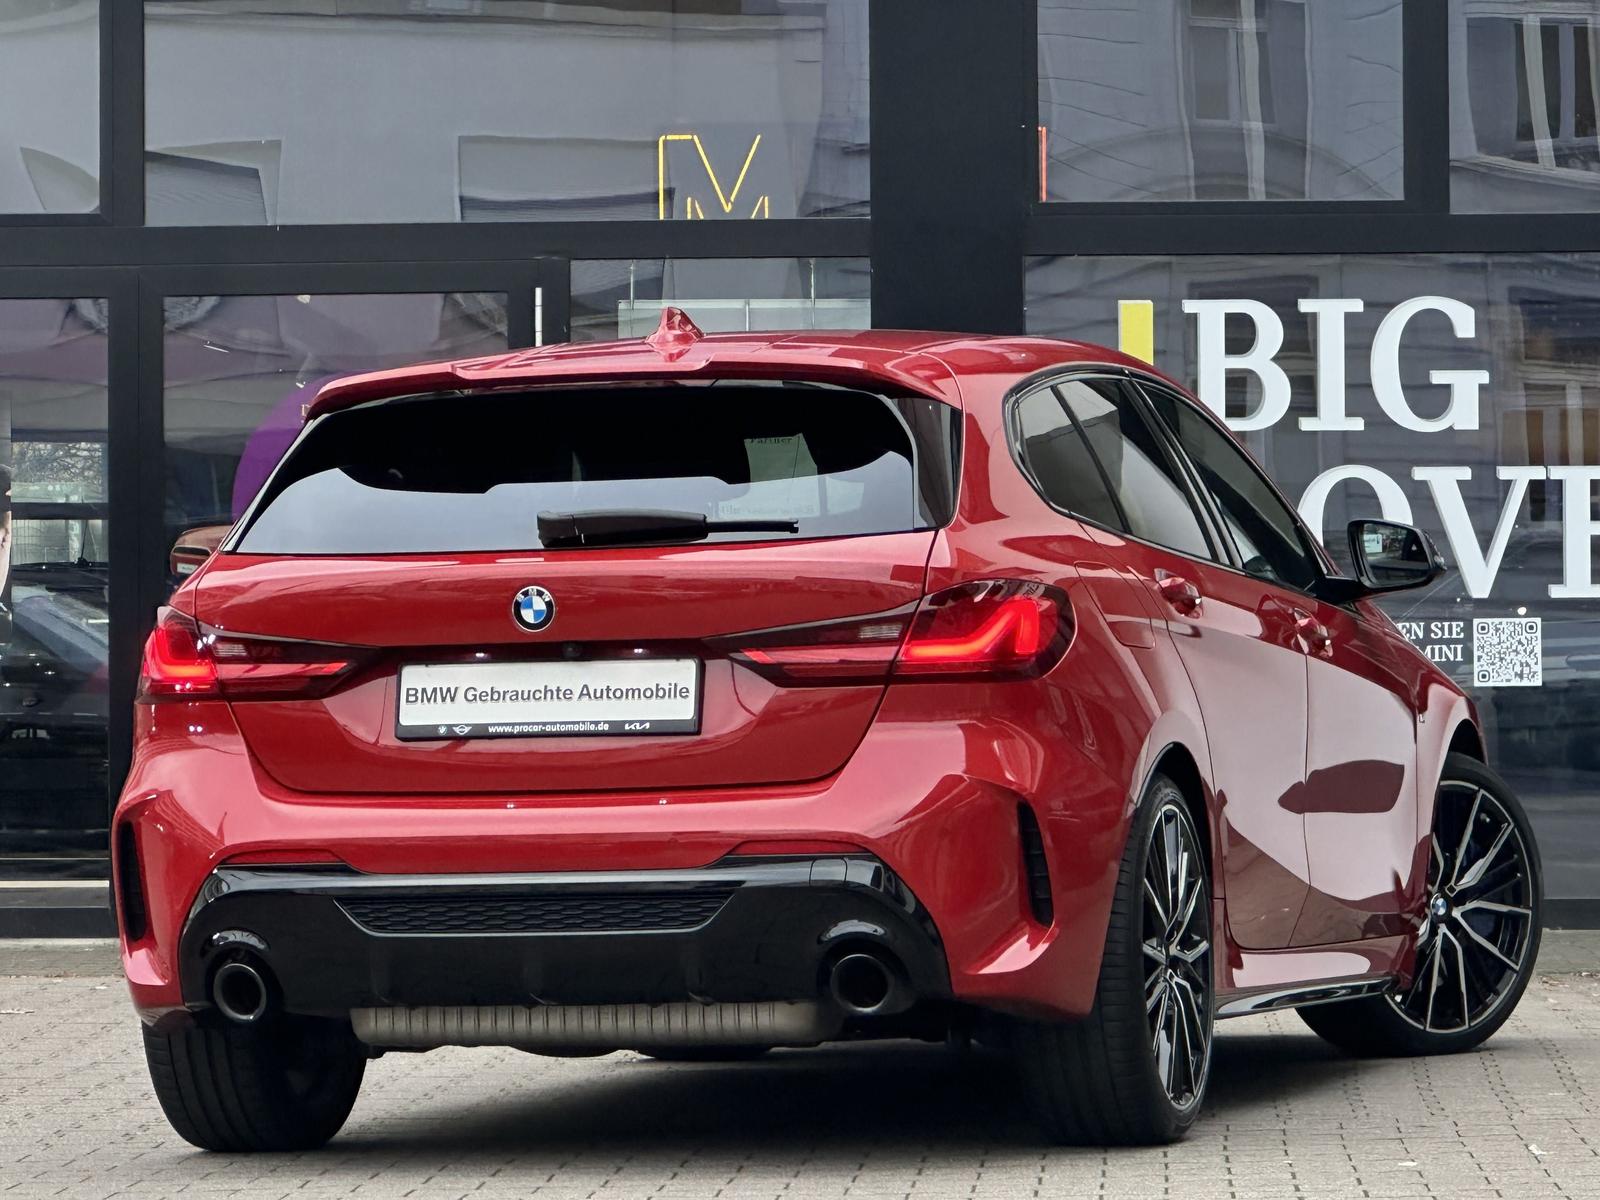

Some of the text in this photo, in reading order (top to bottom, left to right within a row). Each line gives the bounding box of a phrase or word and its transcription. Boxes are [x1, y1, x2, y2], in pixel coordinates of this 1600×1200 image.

[1181, 296, 1490, 433] BIG
[1430, 621, 1464, 639] SIE
[405, 682, 690, 705] BMW Gebrauchte Automobile
[488, 721, 610, 735] www.procar-automobile.de
